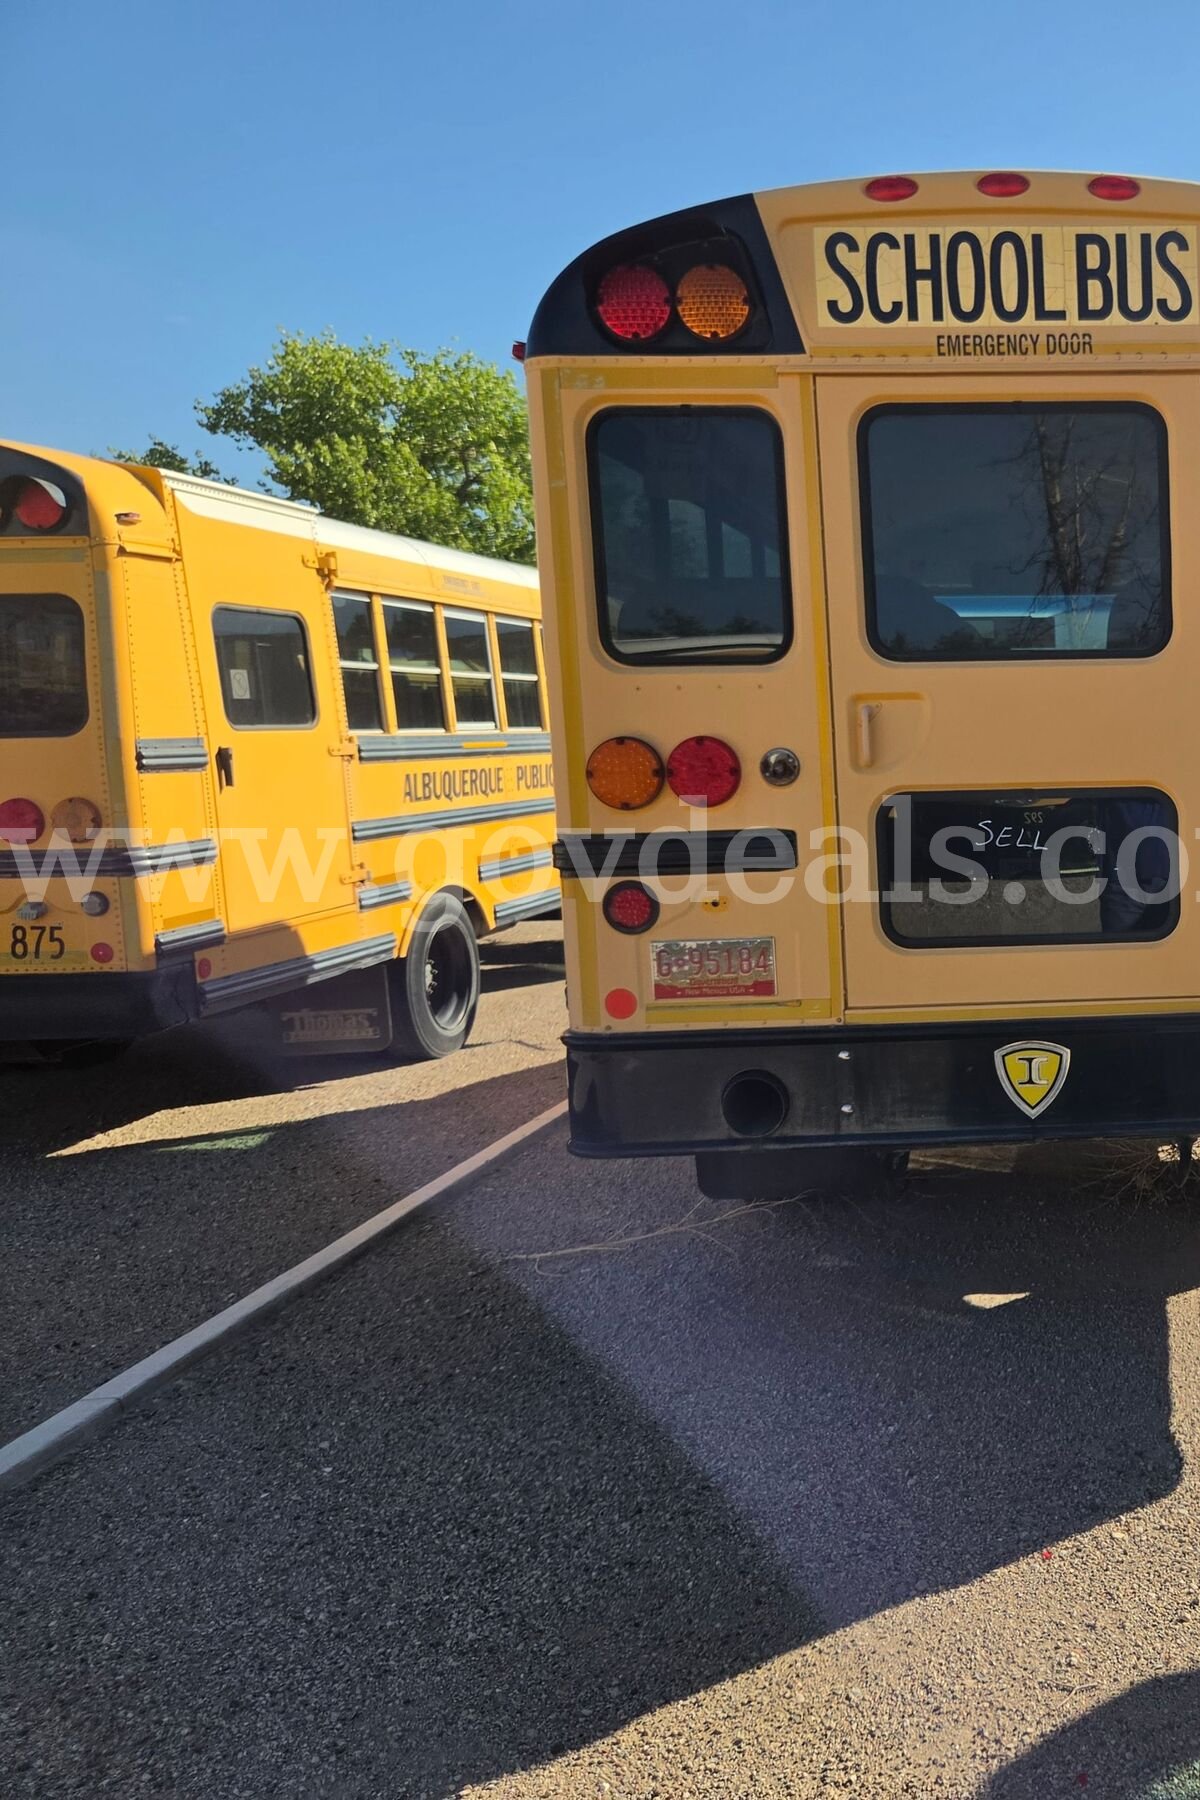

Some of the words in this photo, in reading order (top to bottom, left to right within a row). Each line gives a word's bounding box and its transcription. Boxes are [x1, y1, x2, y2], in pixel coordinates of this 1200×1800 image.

[824, 230, 1067, 324] SCHOOL
[1075, 230, 1193, 322] BUS
[936, 333, 1040, 357] EMERGENCY
[1046, 333, 1093, 355] DOOR
[403, 767, 503, 803] ALBUQUERQUE
[975, 820, 1048, 850] SELL
[11, 925, 65, 960] 875
